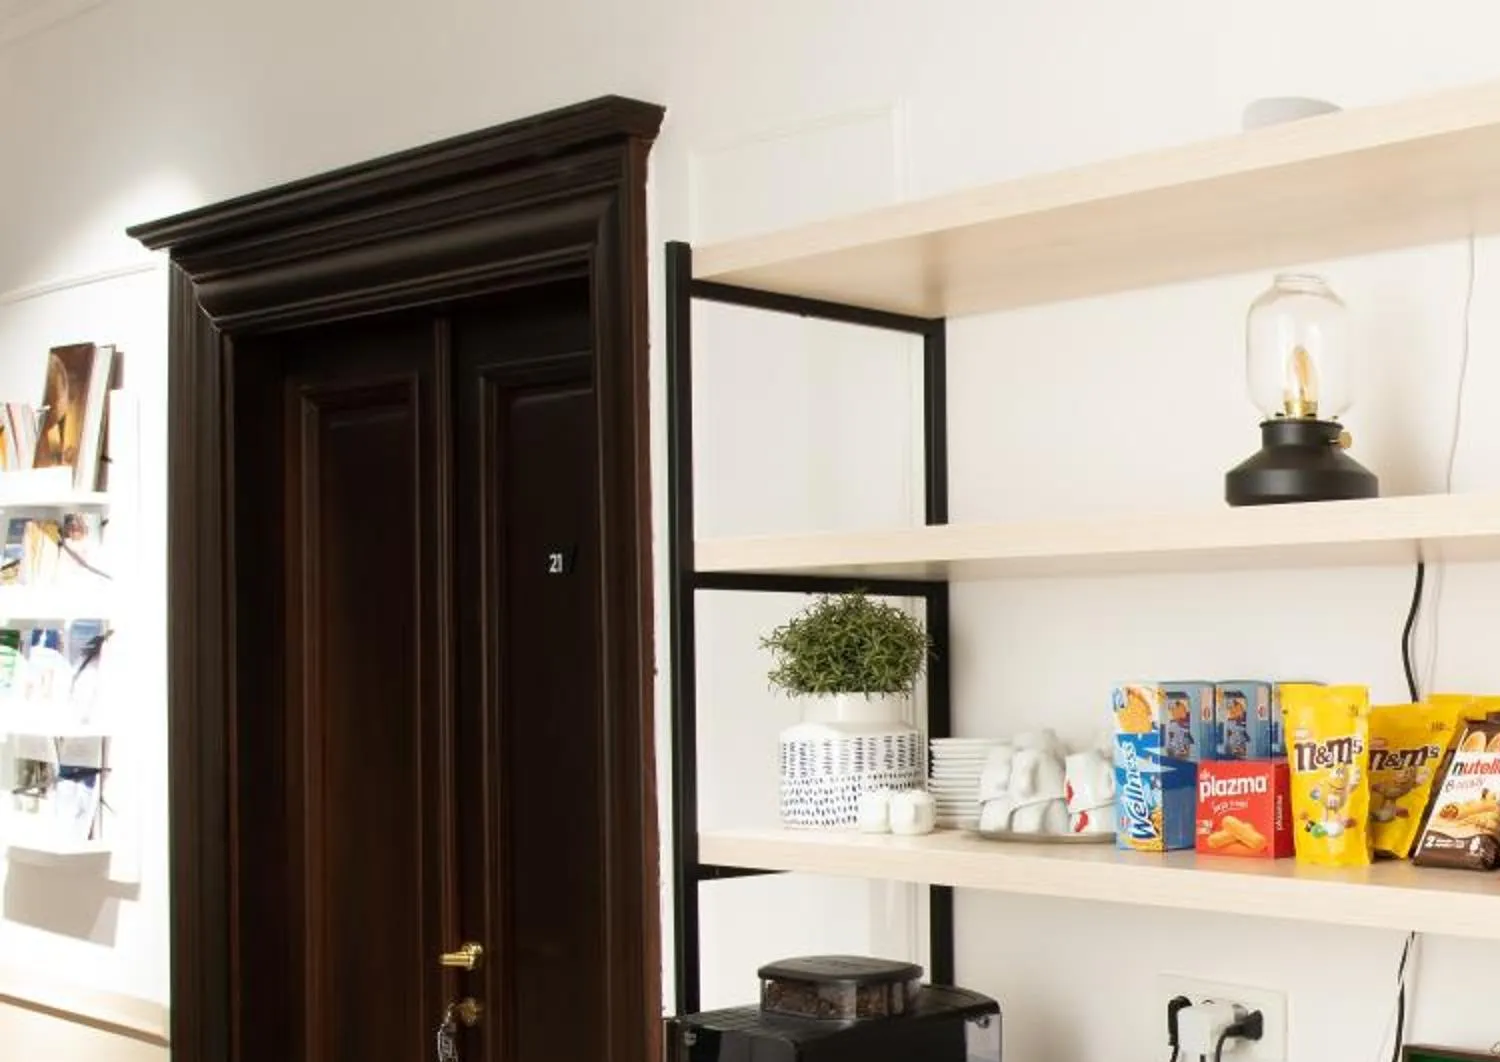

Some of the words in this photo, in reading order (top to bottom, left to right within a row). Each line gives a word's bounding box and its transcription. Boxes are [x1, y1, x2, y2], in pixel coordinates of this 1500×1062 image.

[549, 552, 563, 573] 21
[1121, 742, 1158, 840] Wellness
[1199, 774, 1267, 804] plazma
